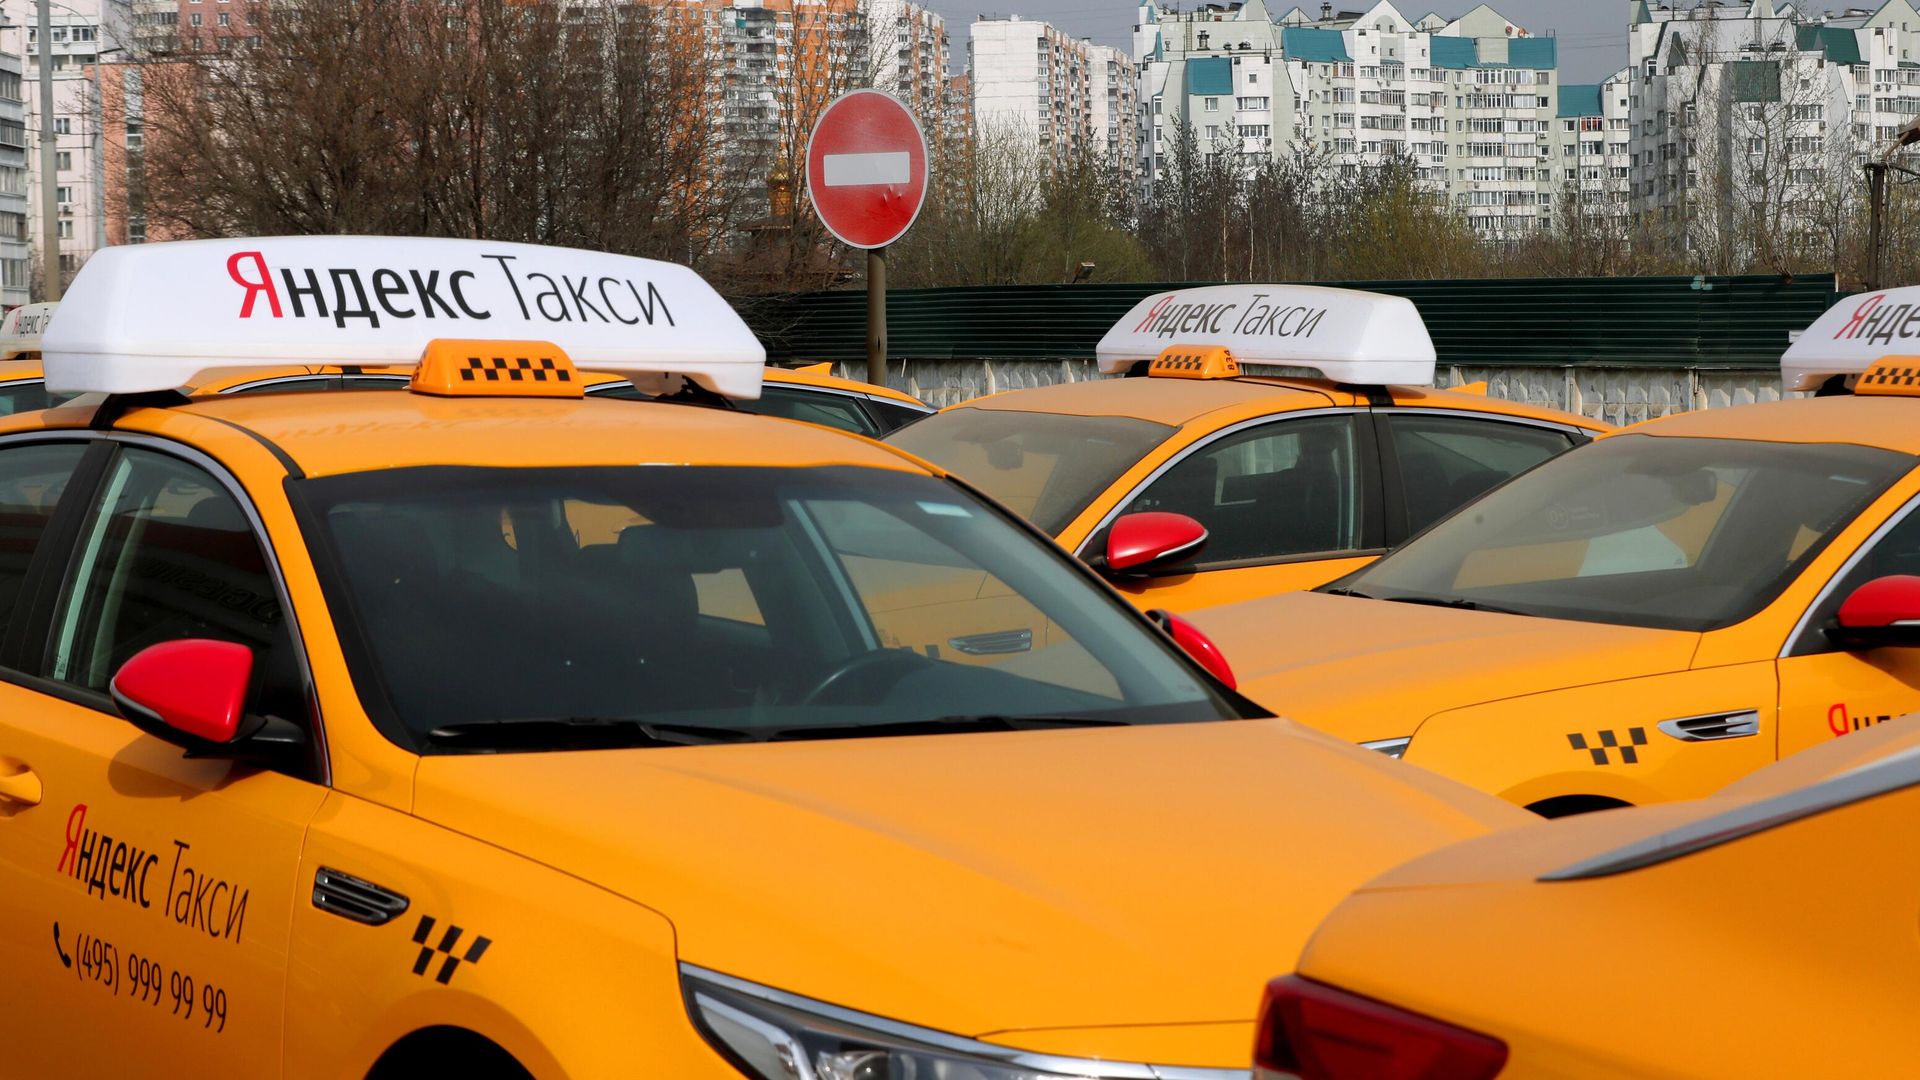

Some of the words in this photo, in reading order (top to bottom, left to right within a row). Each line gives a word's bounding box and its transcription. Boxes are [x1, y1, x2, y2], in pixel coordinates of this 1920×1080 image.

[226, 251, 491, 328] Яндекс
[481, 255, 675, 326] Такси
[1133, 295, 1237, 338] Яндекс
[1233, 295, 1327, 338] Такси
[1832, 294, 1920, 346] Янде
[57, 804, 158, 909] Яндекс
[165, 840, 249, 944] Такси
[76, 932, 119, 996] (495)
[128, 952, 163, 1007] 999
[170, 970, 194, 1021] 99
[202, 984, 228, 1034] 99
